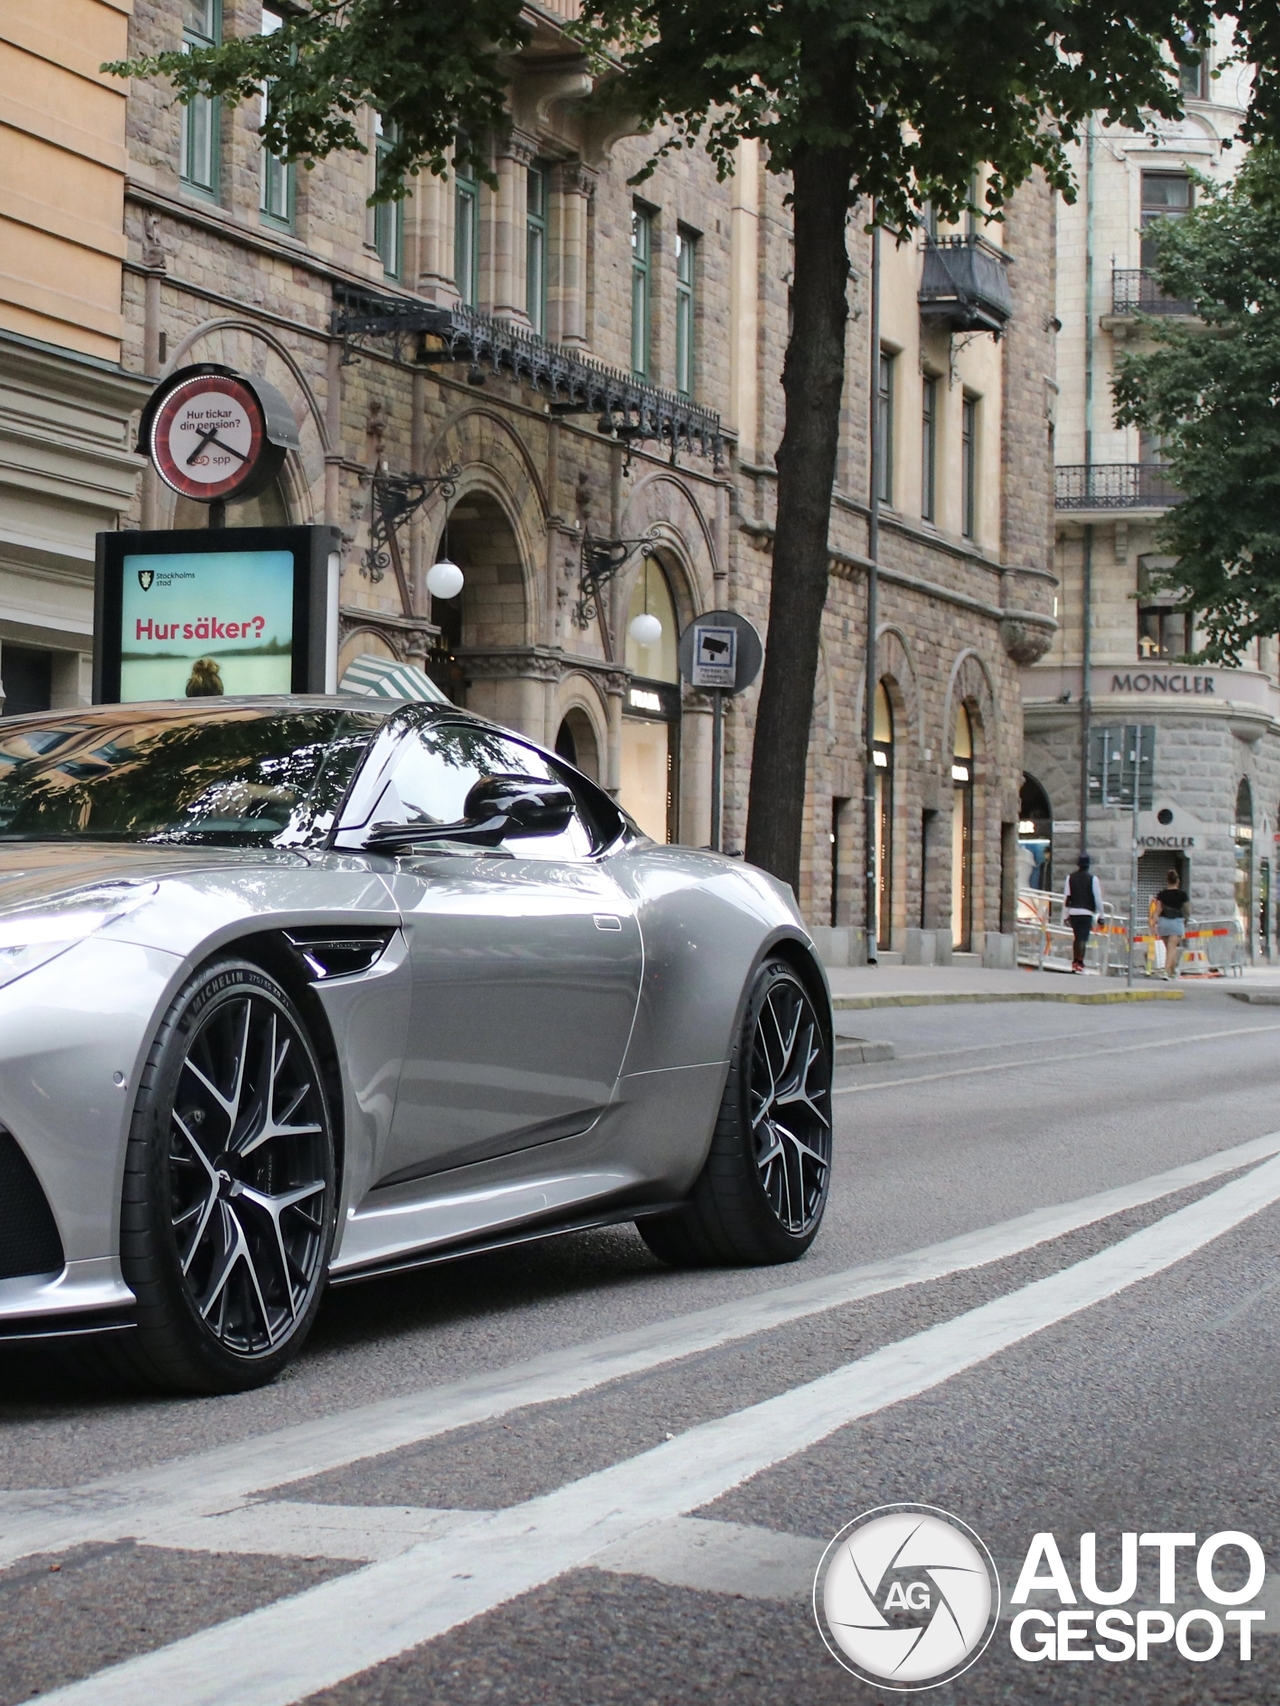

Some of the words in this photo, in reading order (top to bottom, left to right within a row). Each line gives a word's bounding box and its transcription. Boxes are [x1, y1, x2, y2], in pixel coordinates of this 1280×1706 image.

[186, 411, 204, 419] Hur
[206, 409, 232, 419] tickar
[180, 421, 195, 430] din
[197, 419, 241, 431] pension?
[212, 456, 231, 466] spp
[156, 571, 195, 580] Stockholms
[136, 618, 180, 640] Hur
[182, 615, 266, 640] säker?
[1111, 674, 1215, 694] MONCLER
[1136, 836, 1195, 848] MONCLER
[192, 972, 243, 1013] MICHELIN
